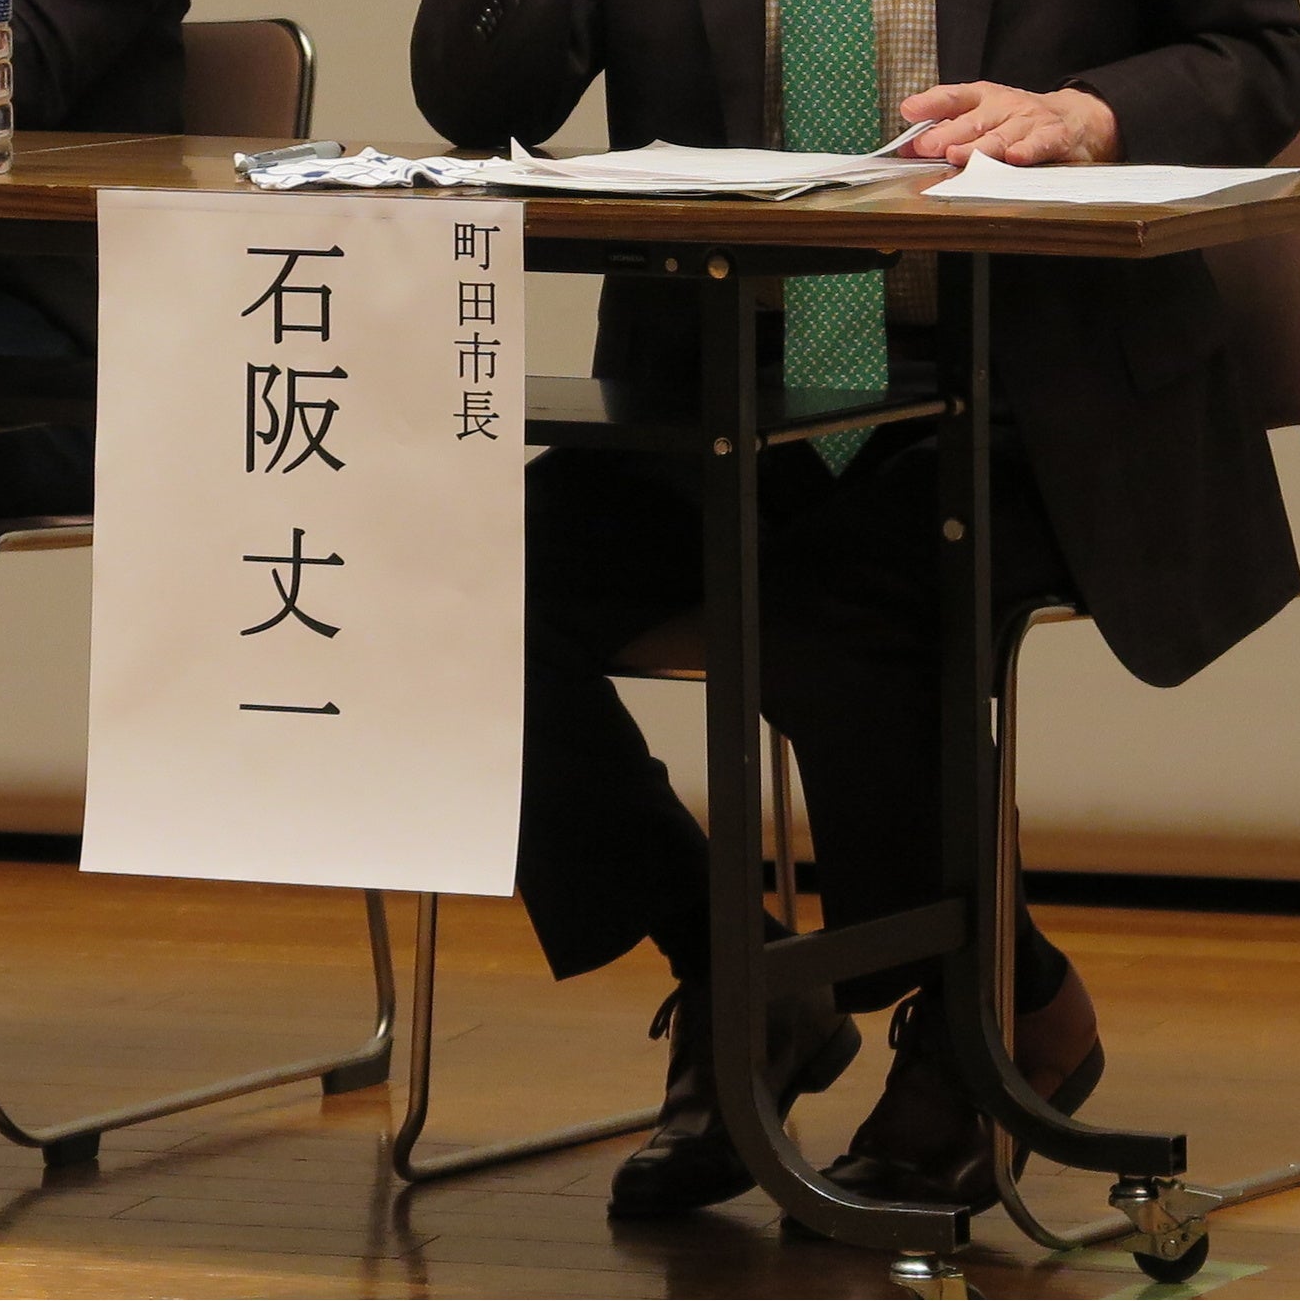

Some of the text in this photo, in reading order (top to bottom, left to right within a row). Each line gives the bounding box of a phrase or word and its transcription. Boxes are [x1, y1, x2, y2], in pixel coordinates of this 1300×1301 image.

[238, 243, 350, 717] 石阪 丈一
[452, 221, 502, 442] 町田市長
